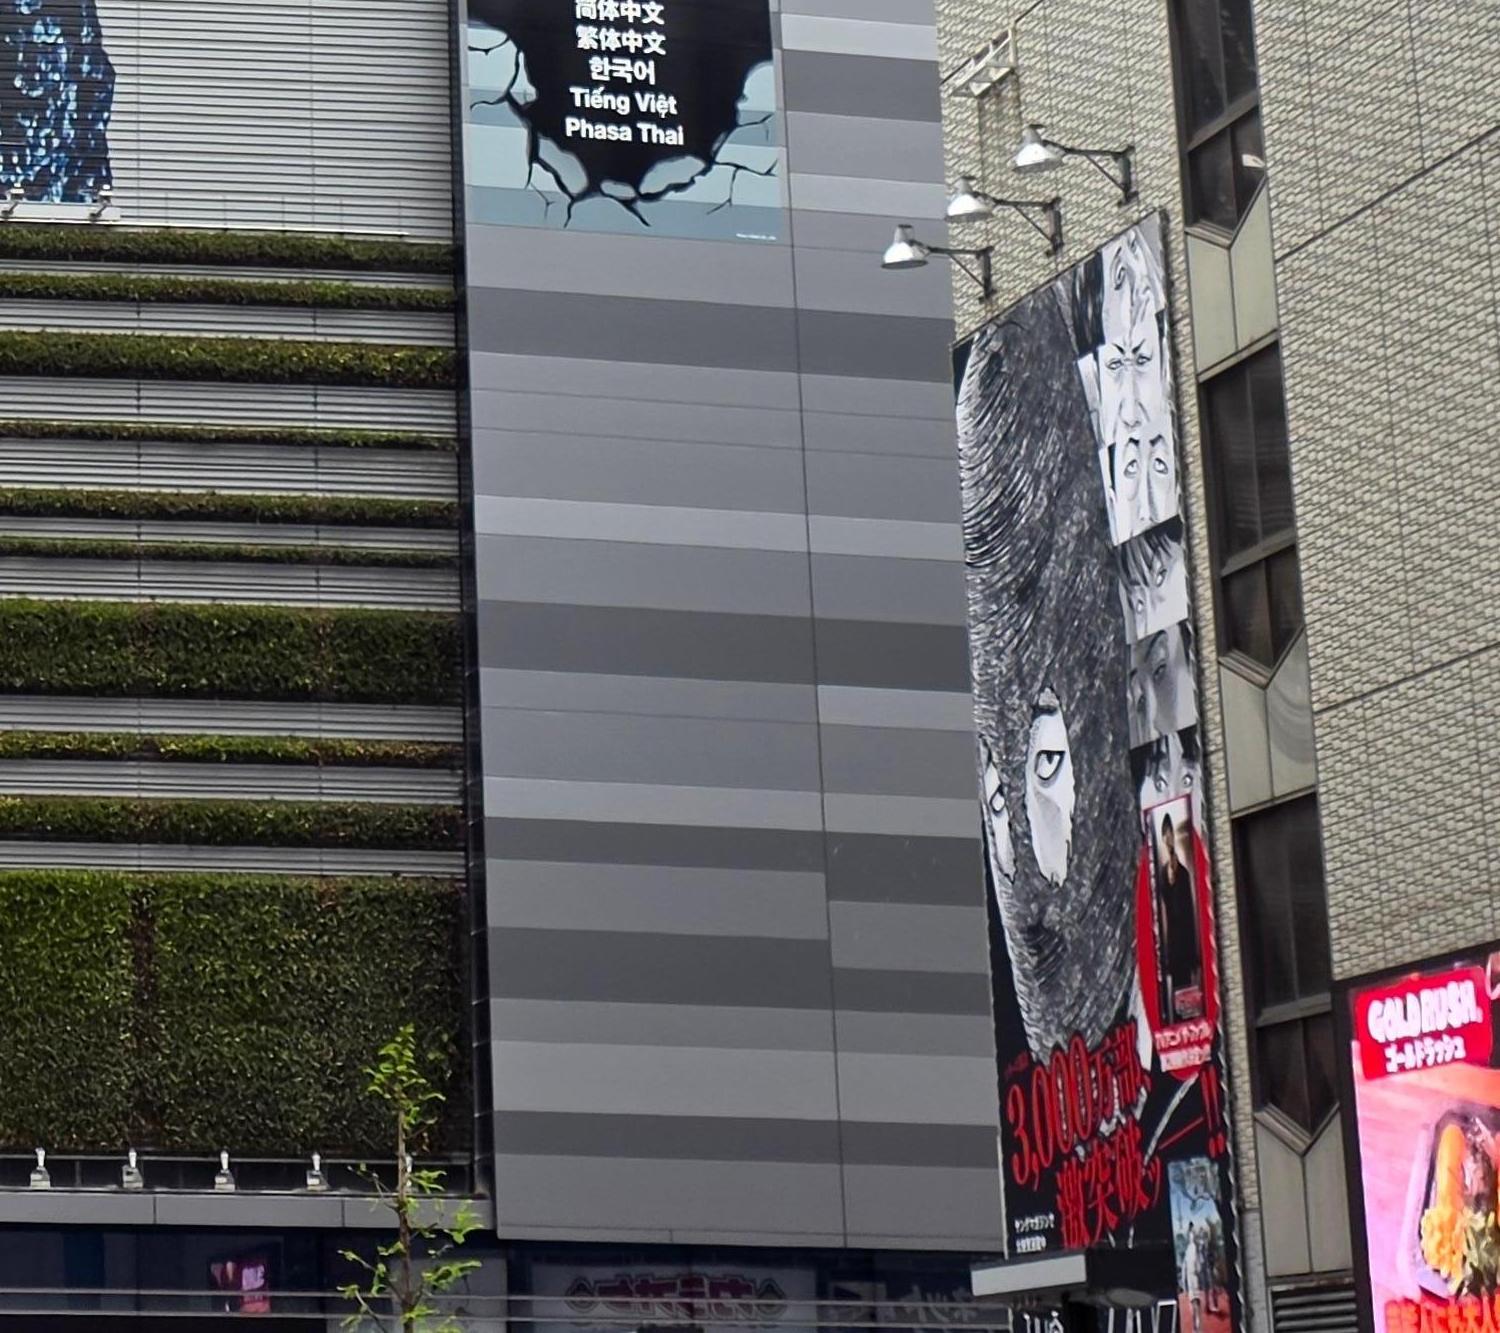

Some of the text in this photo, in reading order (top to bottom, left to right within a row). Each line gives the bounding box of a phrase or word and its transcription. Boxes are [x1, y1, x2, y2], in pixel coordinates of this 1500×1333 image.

[588, 56, 656, 86] 한국어
[569, 85, 678, 119] Tiếng Việt
[564, 116, 684, 146] Phasa Thai
[1367, 991, 1421, 1043] GOLD
[1384, 1033, 1467, 1073] ゴールドラッシュ
